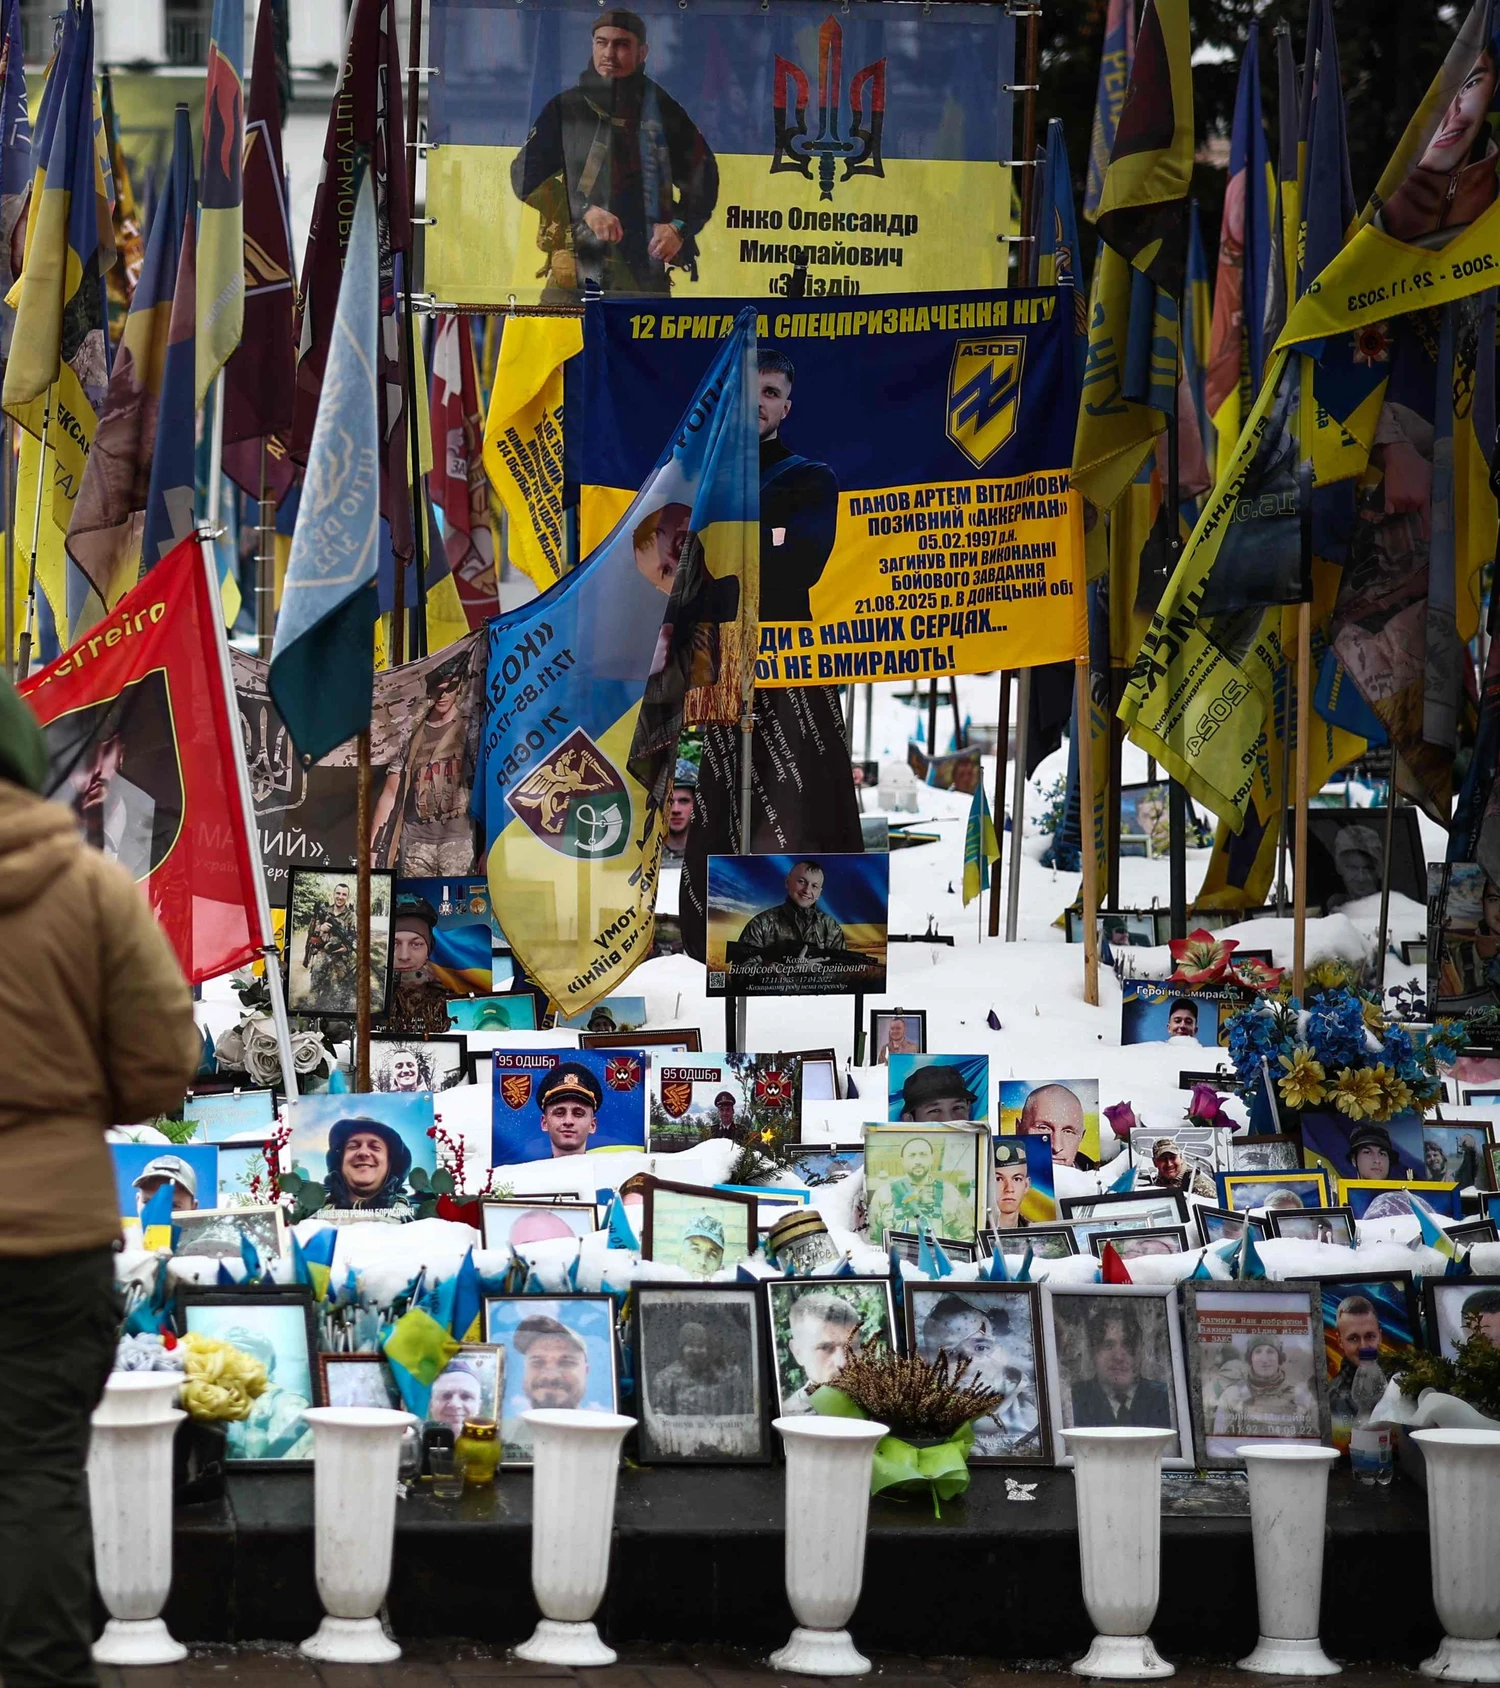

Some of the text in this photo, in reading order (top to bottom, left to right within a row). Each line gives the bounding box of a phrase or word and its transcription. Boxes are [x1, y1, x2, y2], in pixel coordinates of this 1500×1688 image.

[726, 205, 919, 237] Янко Олександр
[739, 239, 903, 267] Миколайович
[769, 274, 860, 297] «Зізді»
[629, 296, 1056, 339] 12 БРИГАА СПЕЦПРИЗНАЧЕННЯ НГУ
[959, 344, 1018, 357] АЗОВ
[497, 438, 508, 458] 414
[849, 491, 911, 517] ПАНОВ
[914, 485, 972, 509] АРТЕМ
[868, 499, 1068, 536] ПОЗИВНИЙ «АККЕРМАН»
[918, 530, 997, 551] 05.02.1997
[879, 541, 1057, 574] ЗАГИНУВ ПРИ ВИКОНАННІ
[891, 562, 1046, 592] БОЙОВОГО ЗАВДАННЯ
[855, 580, 1047, 614] 21.08.2025 р. В ДОНЕЦЬКІЙ
[799, 627, 815, 648] В
[820, 615, 906, 646] НАШИХ
[910, 608, 1008, 640] СЕРЦЯХ...
[784, 654, 813, 680] НЕ
[818, 645, 956, 679] ВМИРАЮТЬ!
[729, 961, 867, 977] Білоусов Сергій Сергійович
[1136, 985, 1182, 998] Герої не
[499, 1055, 556, 1068] 95 ОДШБр
[663, 1068, 718, 1081] 95 ОДШБр
